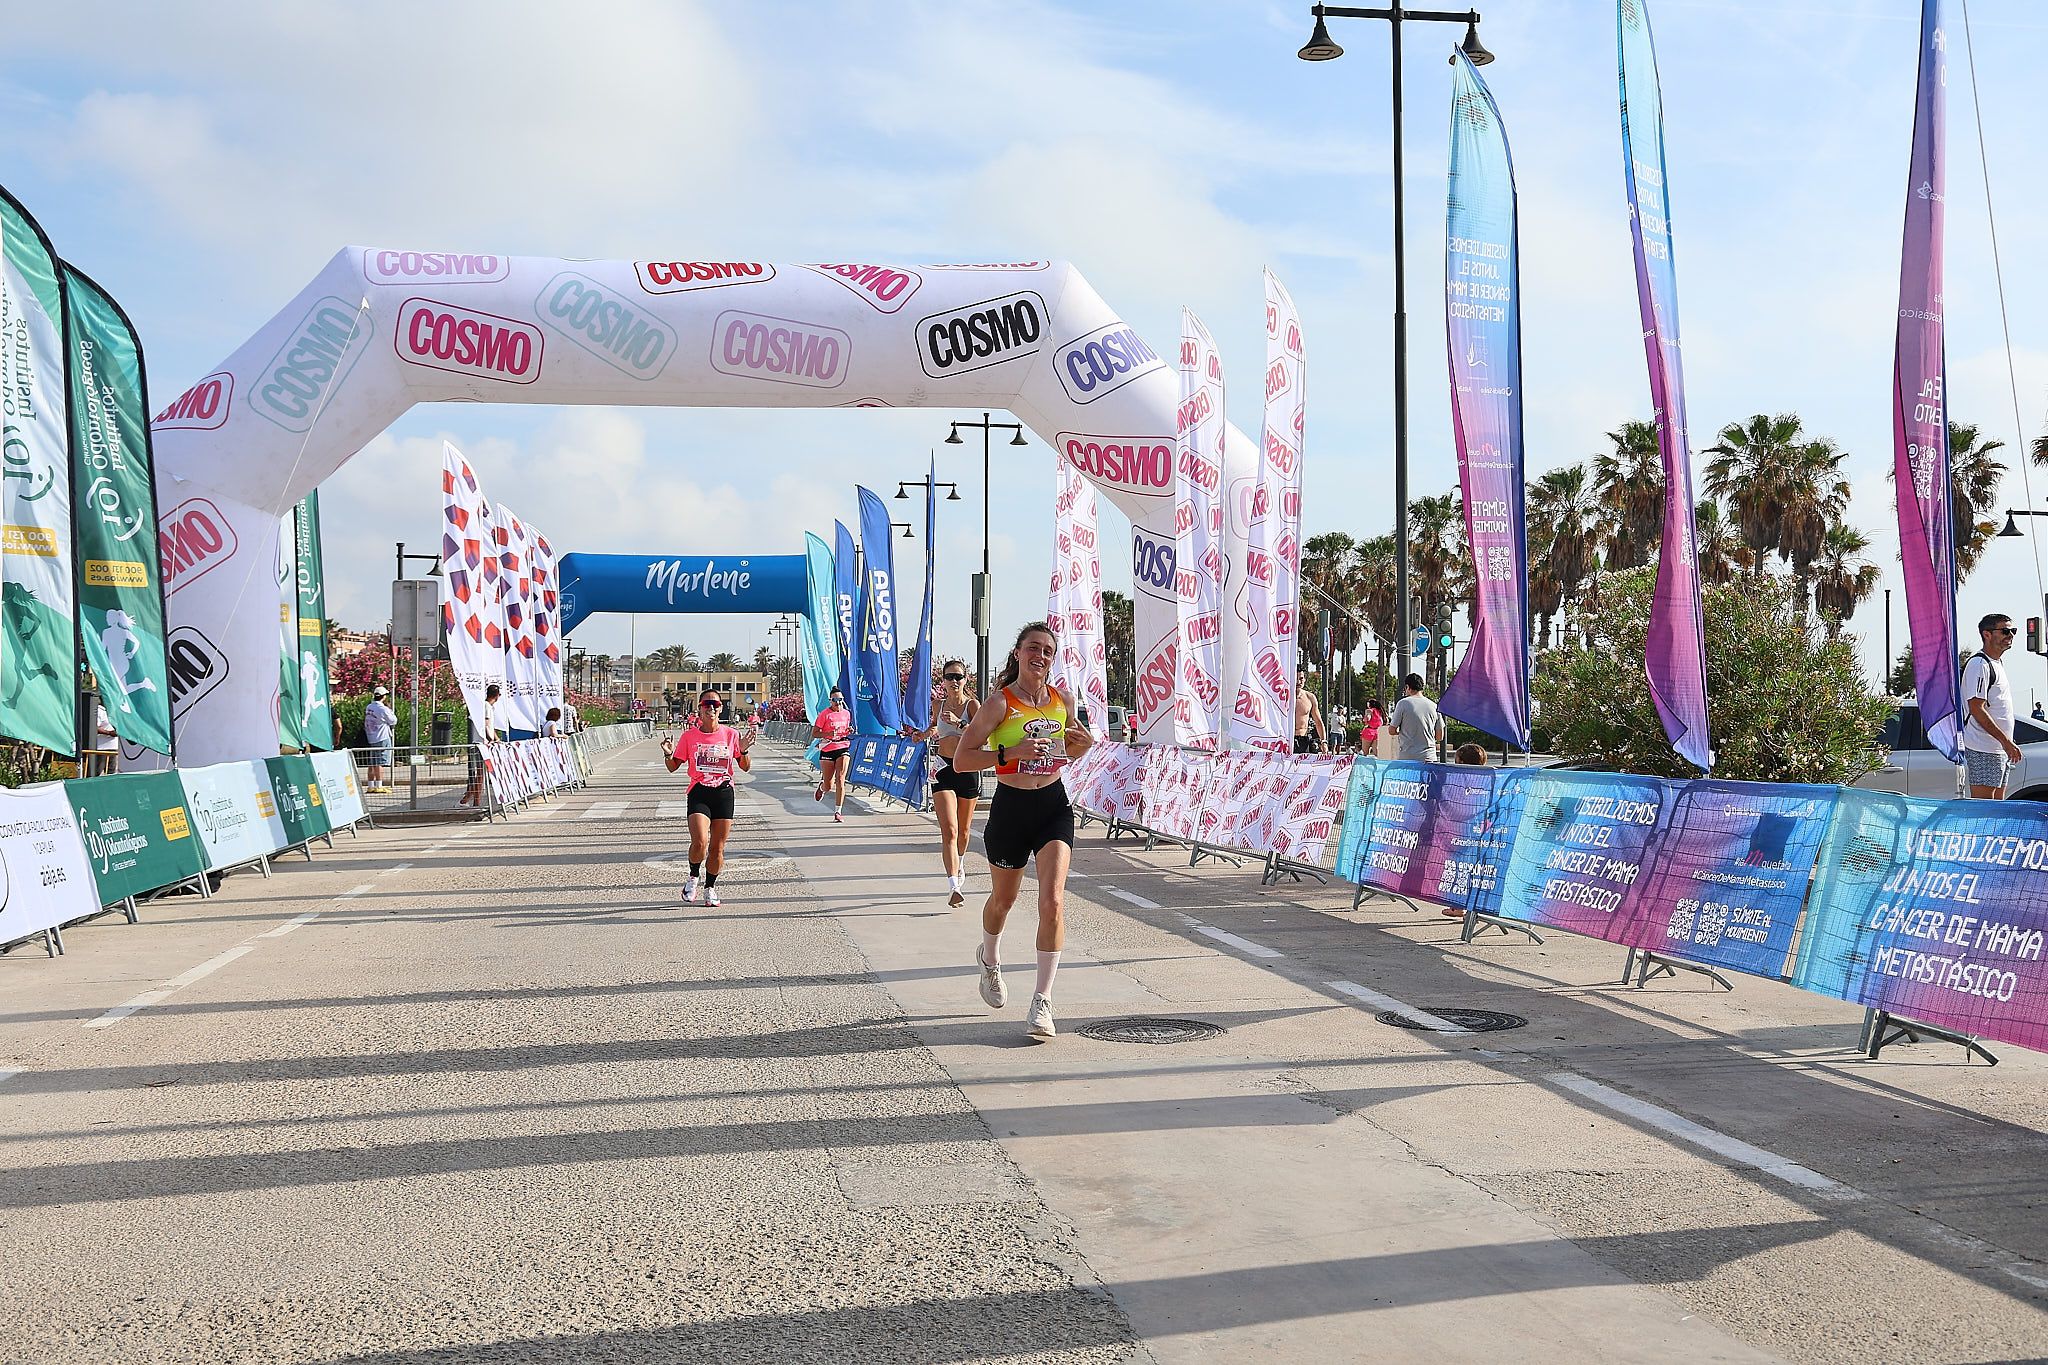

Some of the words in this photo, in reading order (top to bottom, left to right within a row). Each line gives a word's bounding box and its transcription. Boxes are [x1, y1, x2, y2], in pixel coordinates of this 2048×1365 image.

[376, 251, 498, 276] COSMO
[647, 262, 763, 285] COSMO
[820, 263, 910, 301] SMO
[408, 308, 531, 376] COSMO
[548, 280, 665, 370] COSMO
[928, 299, 1041, 369] COSMO
[260, 307, 361, 421] COSMO
[723, 319, 840, 380] COSMO
[156, 379, 222, 424] SMO
[1066, 439, 1172, 488] COSMO
[161, 510, 224, 585] SMO
[645, 559, 751, 605] Marlene
[1028, 722, 1060, 732] Srano
[98, 815, 130, 836] Institutos
[1574, 796, 1659, 826] VISIBILICEMOS
[104, 833, 149, 857] Odontológicos
[1555, 822, 1599, 845] JUNTOS
[1593, 826, 1613, 848] EL
[1545, 845, 1587, 874] CÁNCER
[1582, 853, 1606, 877] DE
[1599, 858, 1640, 886] MAMA
[1883, 866, 1957, 900] JUNTOS
[1952, 873, 1981, 905] EL
[1542, 878, 1622, 913] METASTÁSICO
[1730, 903, 1765, 925] SÚMATE
[1762, 913, 1772, 928] AL
[1724, 925, 1768, 944] MOVIMIENTO
[1871, 903, 1946, 942] CÁNCER
[1943, 914, 1978, 947] DE
[1974, 919, 2045, 961] MAMA
[1873, 945, 2018, 1003] METASTÁSICO
